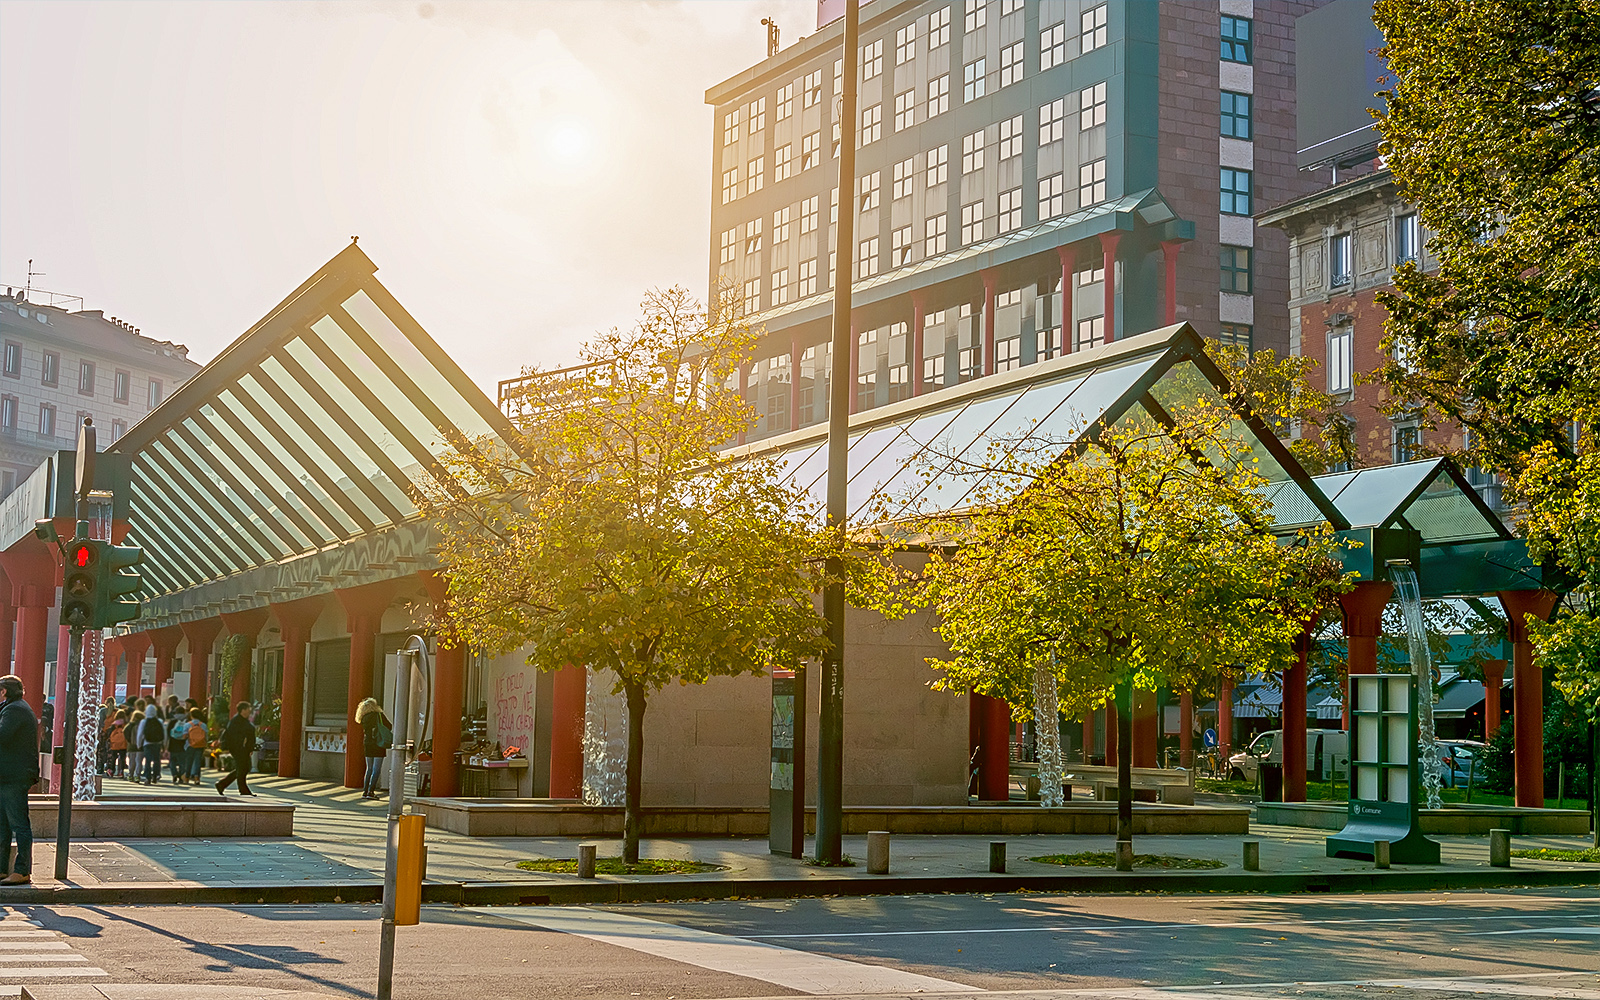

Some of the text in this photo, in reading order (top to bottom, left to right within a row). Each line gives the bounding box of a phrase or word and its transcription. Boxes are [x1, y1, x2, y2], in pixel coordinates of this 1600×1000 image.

[506, 672, 524, 692] DELLO
[497, 695, 517, 716] STATO
[498, 713, 514, 733] DELLA
[1361, 806, 1382, 815] Comune
